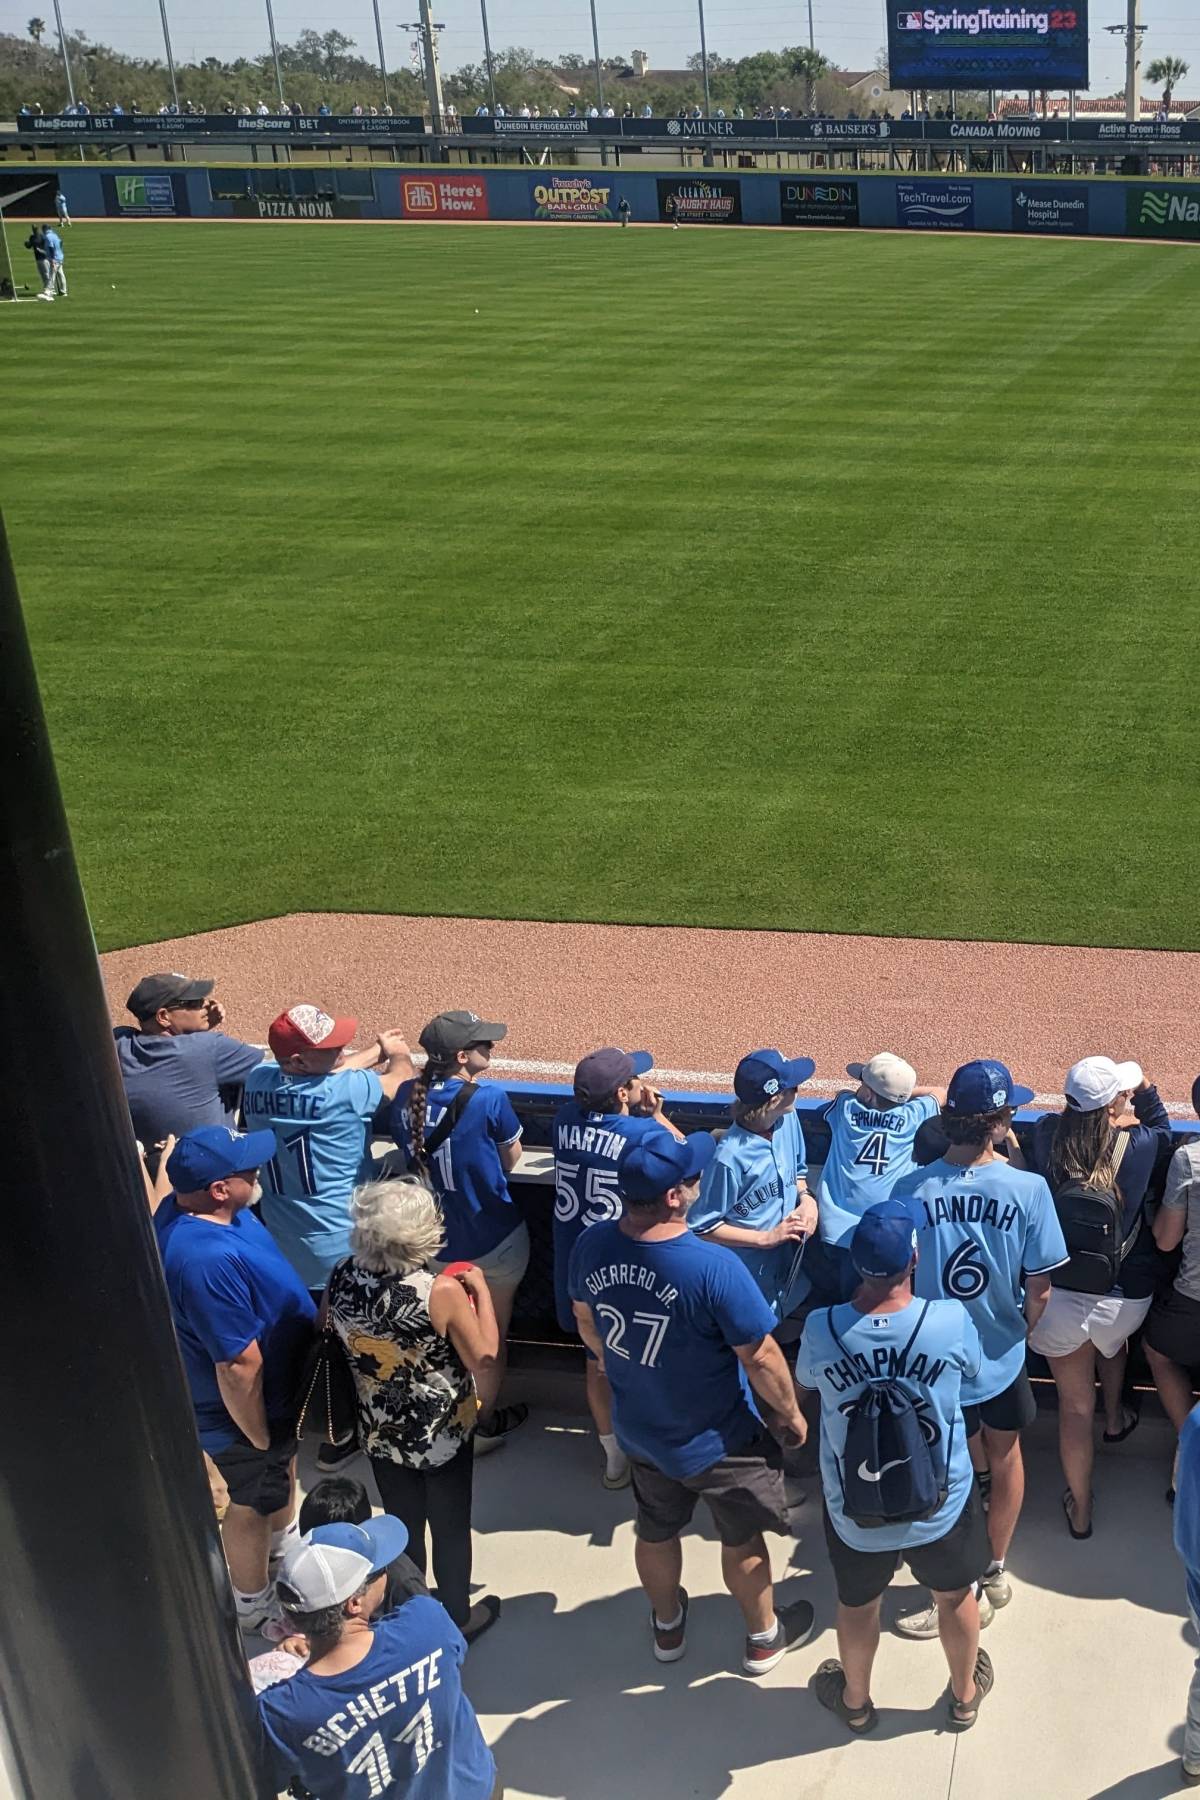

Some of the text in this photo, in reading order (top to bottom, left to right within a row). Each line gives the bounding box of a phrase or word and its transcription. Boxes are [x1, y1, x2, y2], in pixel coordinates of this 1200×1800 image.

[1051, 11, 1076, 29] 23
[34, 119, 114, 129] theScore BET
[238, 119, 319, 129] theScore BET
[683, 122, 735, 135] MILNER
[826, 124, 876, 135] BAUSER'S
[951, 124, 1041, 137] CANADA MOVING
[1099, 124, 1126, 134] Active
[440, 184, 482, 197] Here's
[534, 186, 610, 204] OUTPOST
[899, 192, 972, 204] TechTravel.com
[258, 202, 334, 218] PIZZA NOVA
[1027, 199, 1085, 209] Mease Dunedin
[1028, 210, 1059, 220] Hospital
[851, 1112, 906, 1133] SPRINGER
[558, 1125, 628, 1161] MARTIN
[854, 1132, 891, 1176] 4
[554, 1160, 623, 1228] 55
[734, 1177, 780, 1218] BLUE
[942, 1239, 990, 1301] 6
[585, 1263, 681, 1310] GUERRERO JR.
[595, 1303, 671, 1369] 27
[824, 1347, 948, 1393] CHAPMAN
[302, 1648, 444, 1757] BICHETTE
